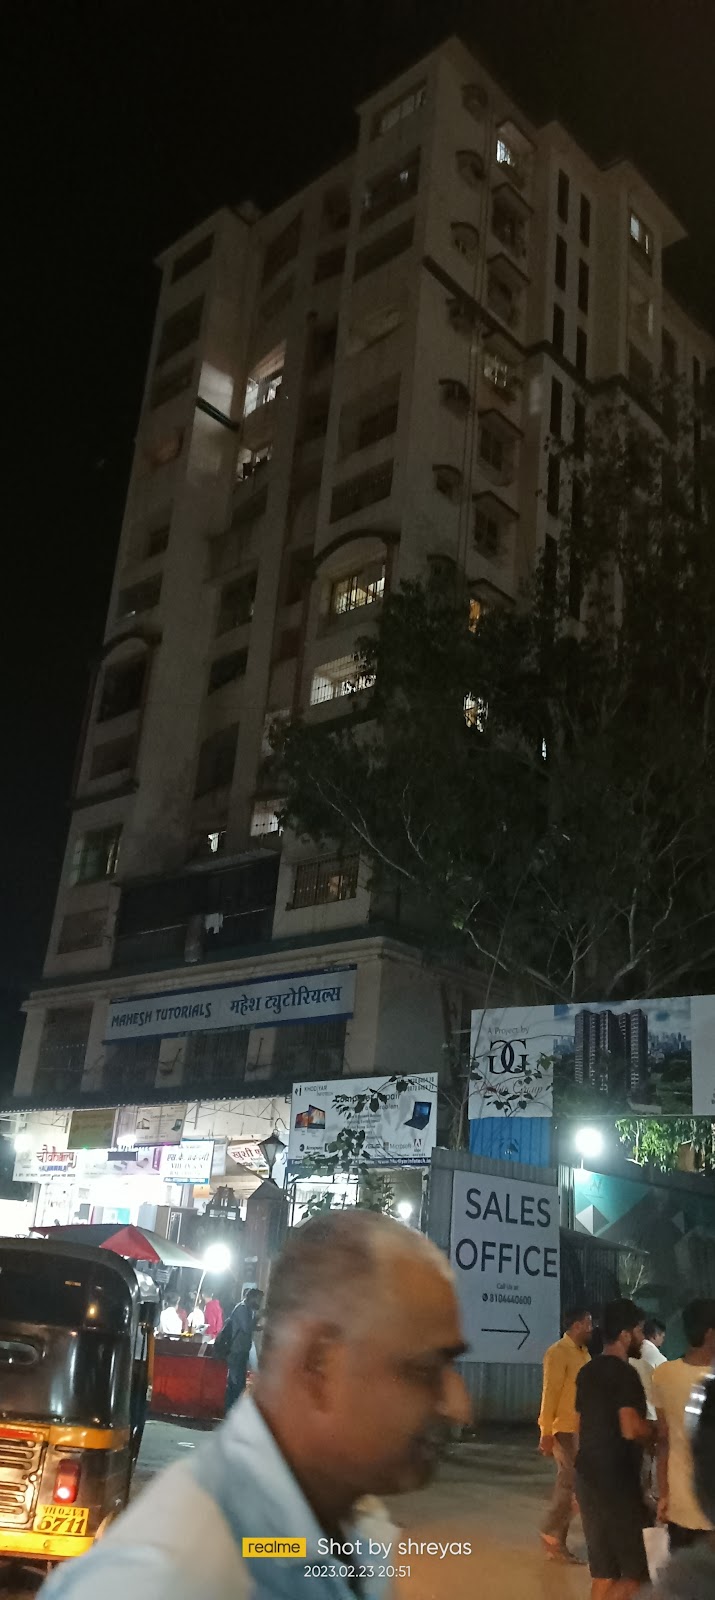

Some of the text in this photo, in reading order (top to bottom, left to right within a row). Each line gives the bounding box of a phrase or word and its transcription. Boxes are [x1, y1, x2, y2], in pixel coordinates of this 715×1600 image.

[111, 1002, 212, 1027] MAHESH TUTORIALS
[230, 994, 262, 1015] महेश
[495, 1027, 518, 1035] Project
[521, 1026, 530, 1034] by
[465, 1188, 551, 1228] SALES
[455, 1238, 558, 1278] OFFICE
[496, 1282, 506, 1290] Call
[37, 1515, 85, 1533] 6711
